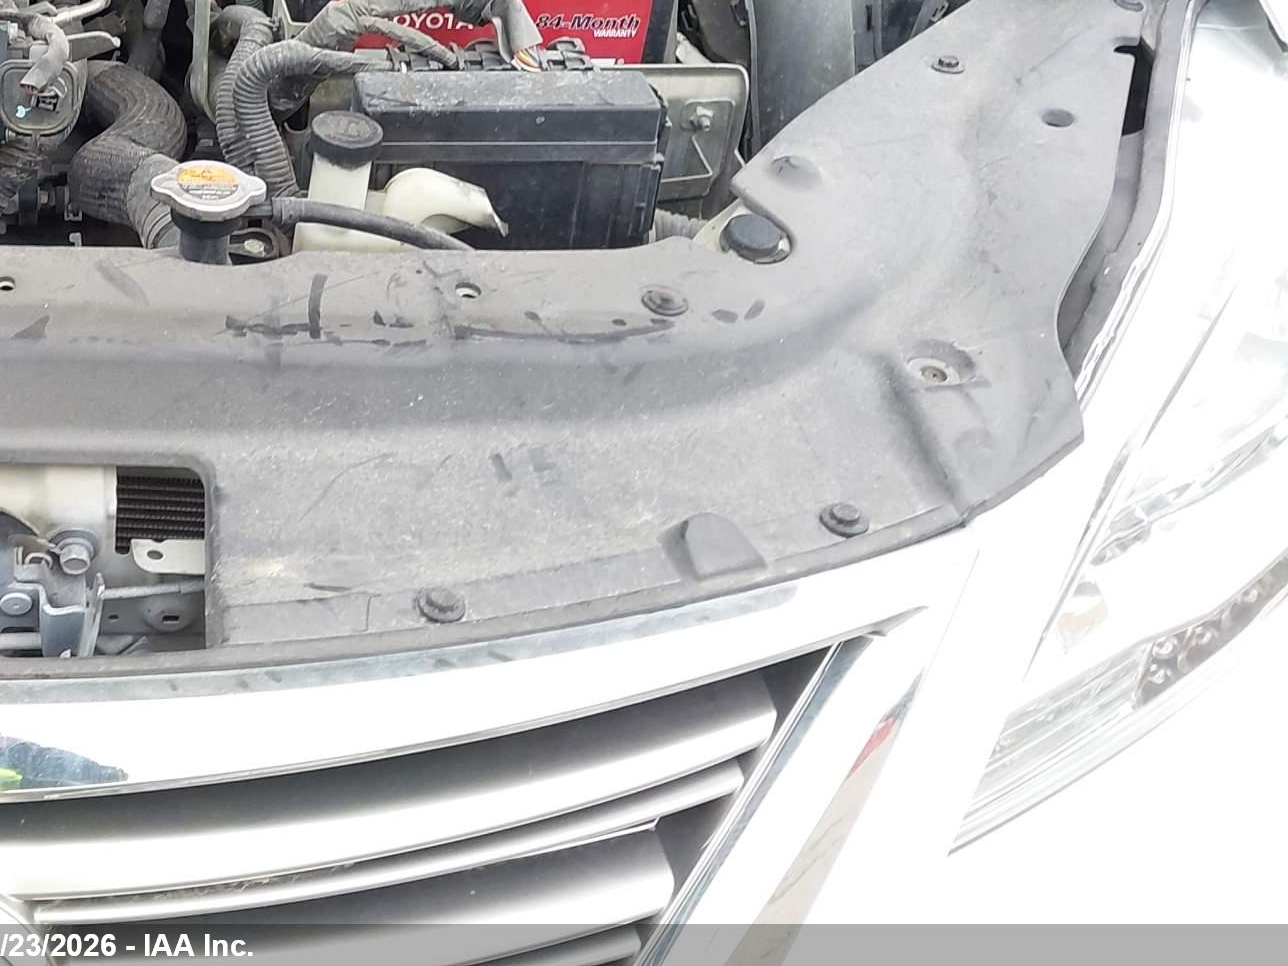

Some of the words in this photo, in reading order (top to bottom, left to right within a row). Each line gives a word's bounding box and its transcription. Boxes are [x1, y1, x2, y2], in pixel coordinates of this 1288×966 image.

[392, 12, 474, 31] OYOT
[535, 13, 641, 31] 84-Month
[592, 28, 638, 38] WARRANTY
